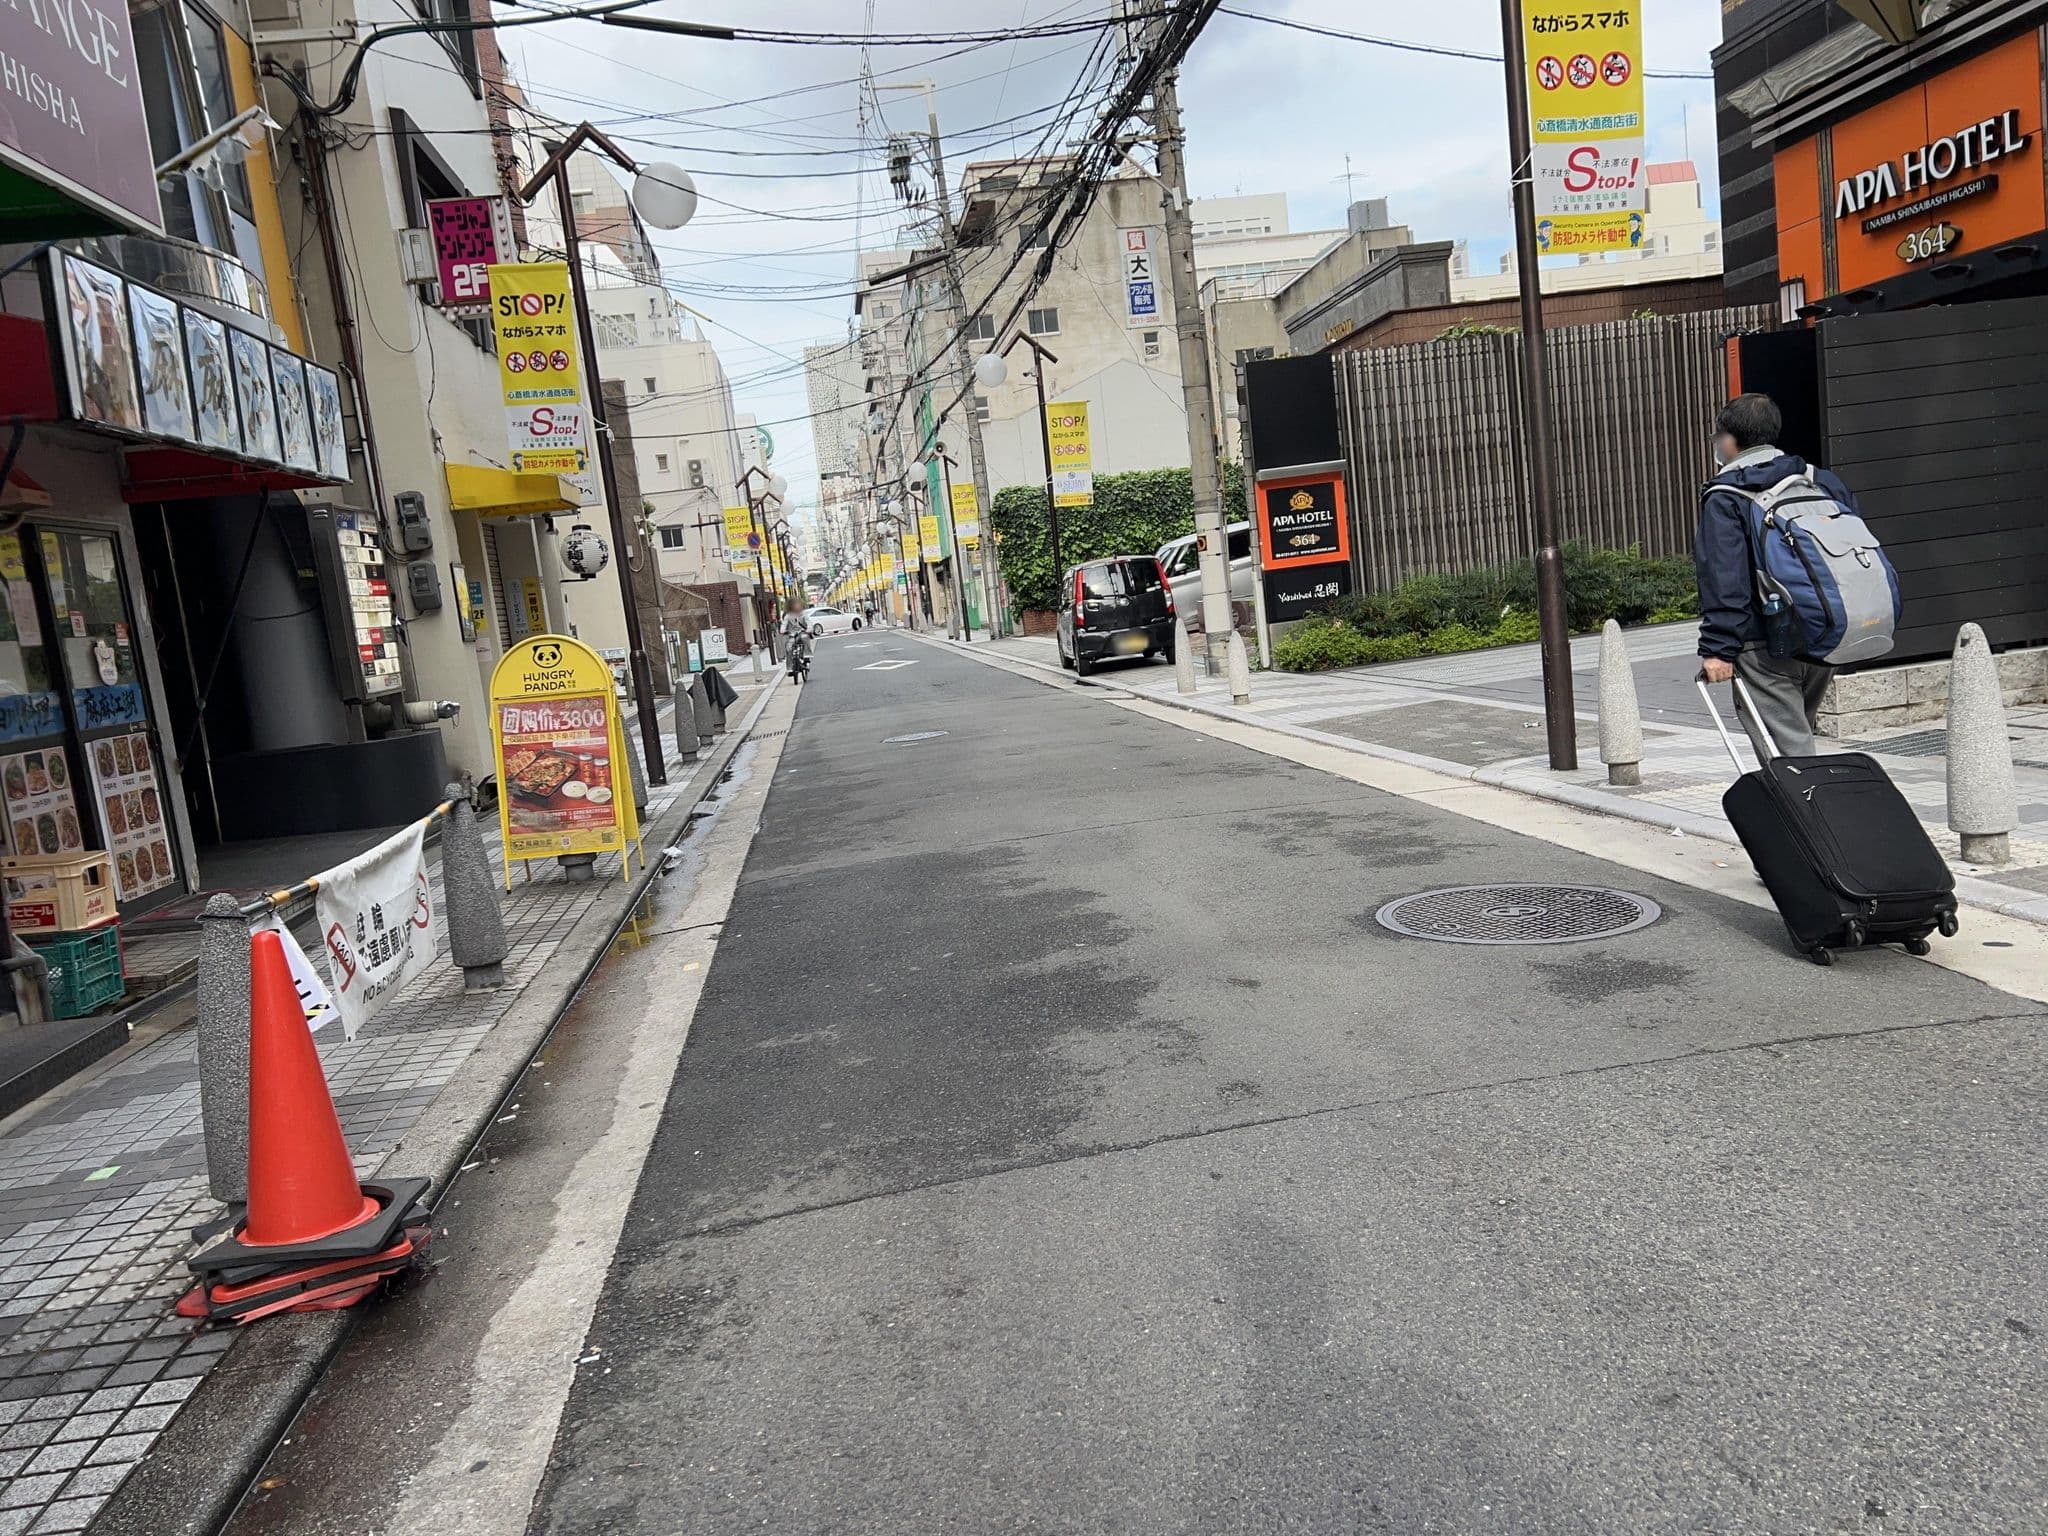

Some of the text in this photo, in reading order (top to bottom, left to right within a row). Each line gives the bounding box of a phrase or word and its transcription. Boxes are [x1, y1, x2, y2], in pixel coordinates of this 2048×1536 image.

[1532, 10, 1629, 33] ながらスマホ
[1537, 113, 1638, 132] 心斎橋清水通商店街
[1563, 146, 1639, 192] Stop!
[1835, 110, 2024, 219] APA HOTEL
[431, 204, 491, 232] マージャン
[1553, 226, 1628, 246] 防犯カメラ作動中
[1905, 223, 1946, 263] 364
[452, 262, 490, 297] 2F
[499, 292, 565, 317] STOP!
[502, 325, 567, 339] ながらスマホ
[529, 407, 579, 437] Stop!
[1273, 515, 1296, 527] APA
[1297, 510, 1334, 525] HOTEL
[1294, 533, 1316, 547] 364
[473, 609, 486, 620] 2F
[523, 669, 575, 682] HUNGRY
[524, 681, 567, 693] PANDA
[363, 985, 375, 1005] NO
